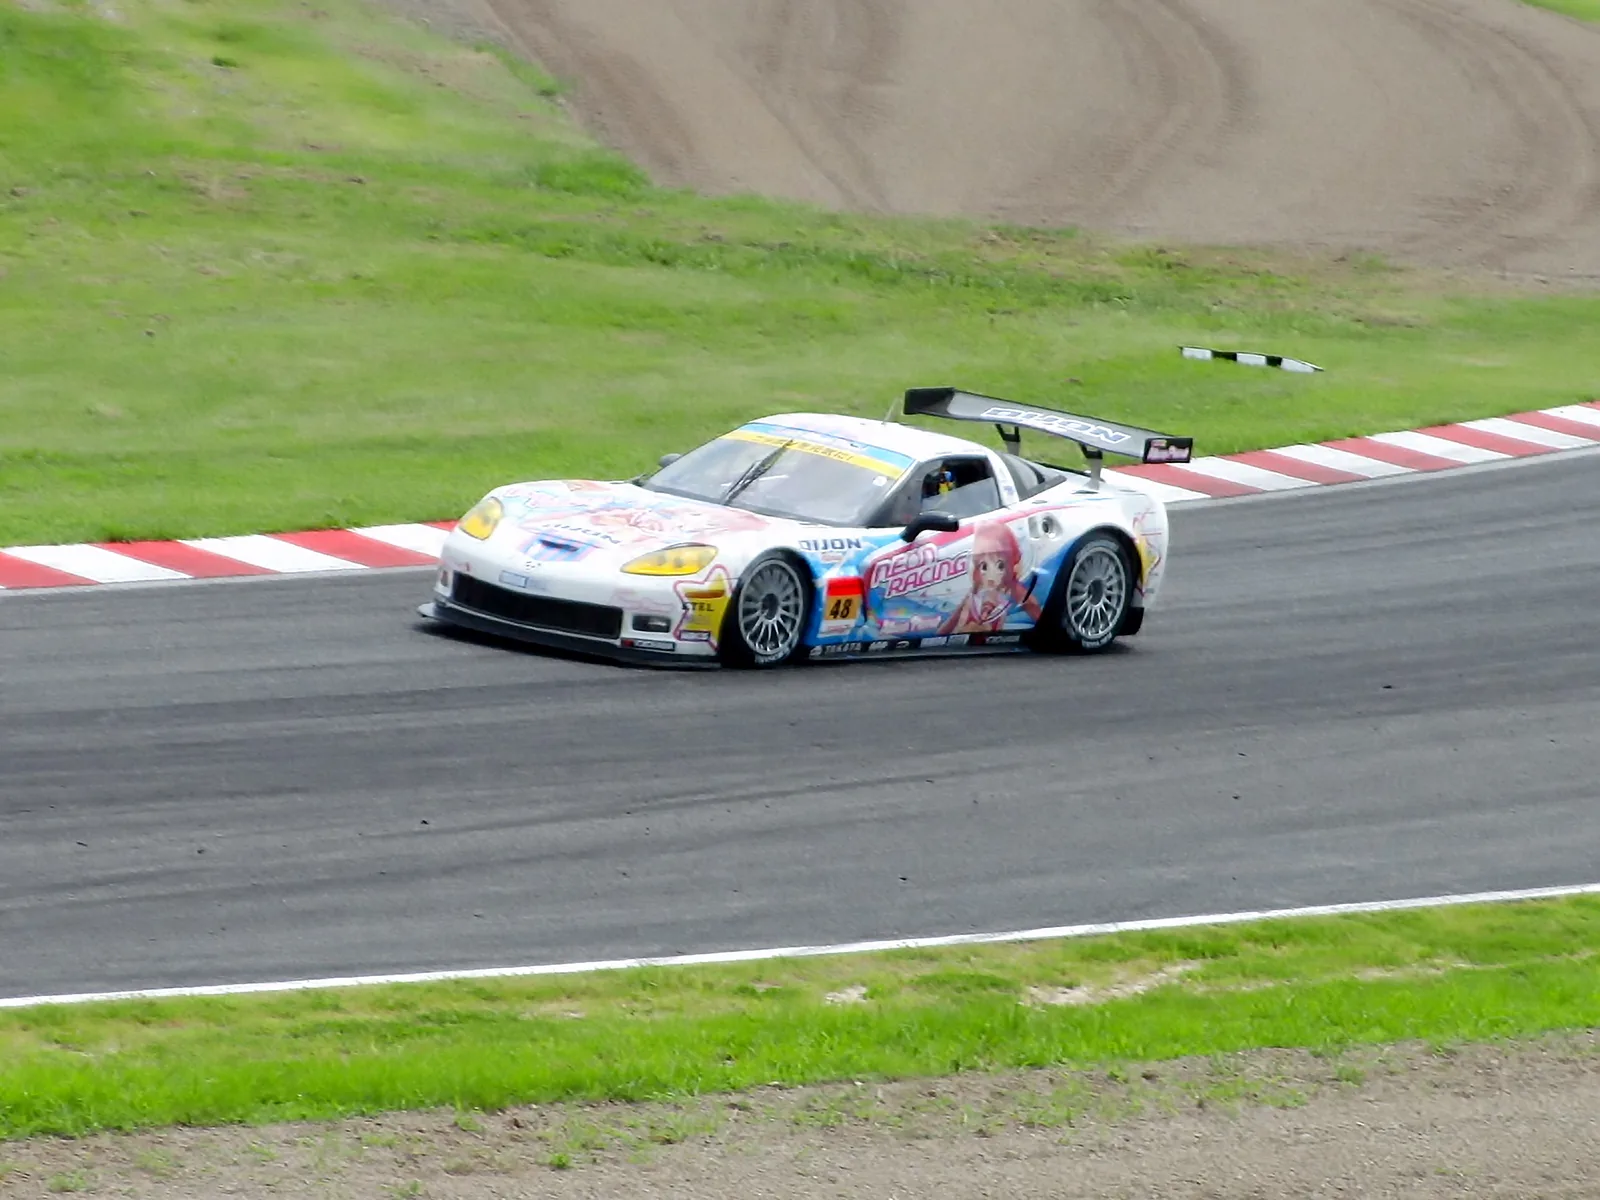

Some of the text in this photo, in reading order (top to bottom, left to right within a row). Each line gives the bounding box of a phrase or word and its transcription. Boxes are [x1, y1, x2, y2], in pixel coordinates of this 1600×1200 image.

[980, 407, 1131, 444] DIJON
[799, 538, 862, 551] DIJON
[829, 598, 853, 619] 48
